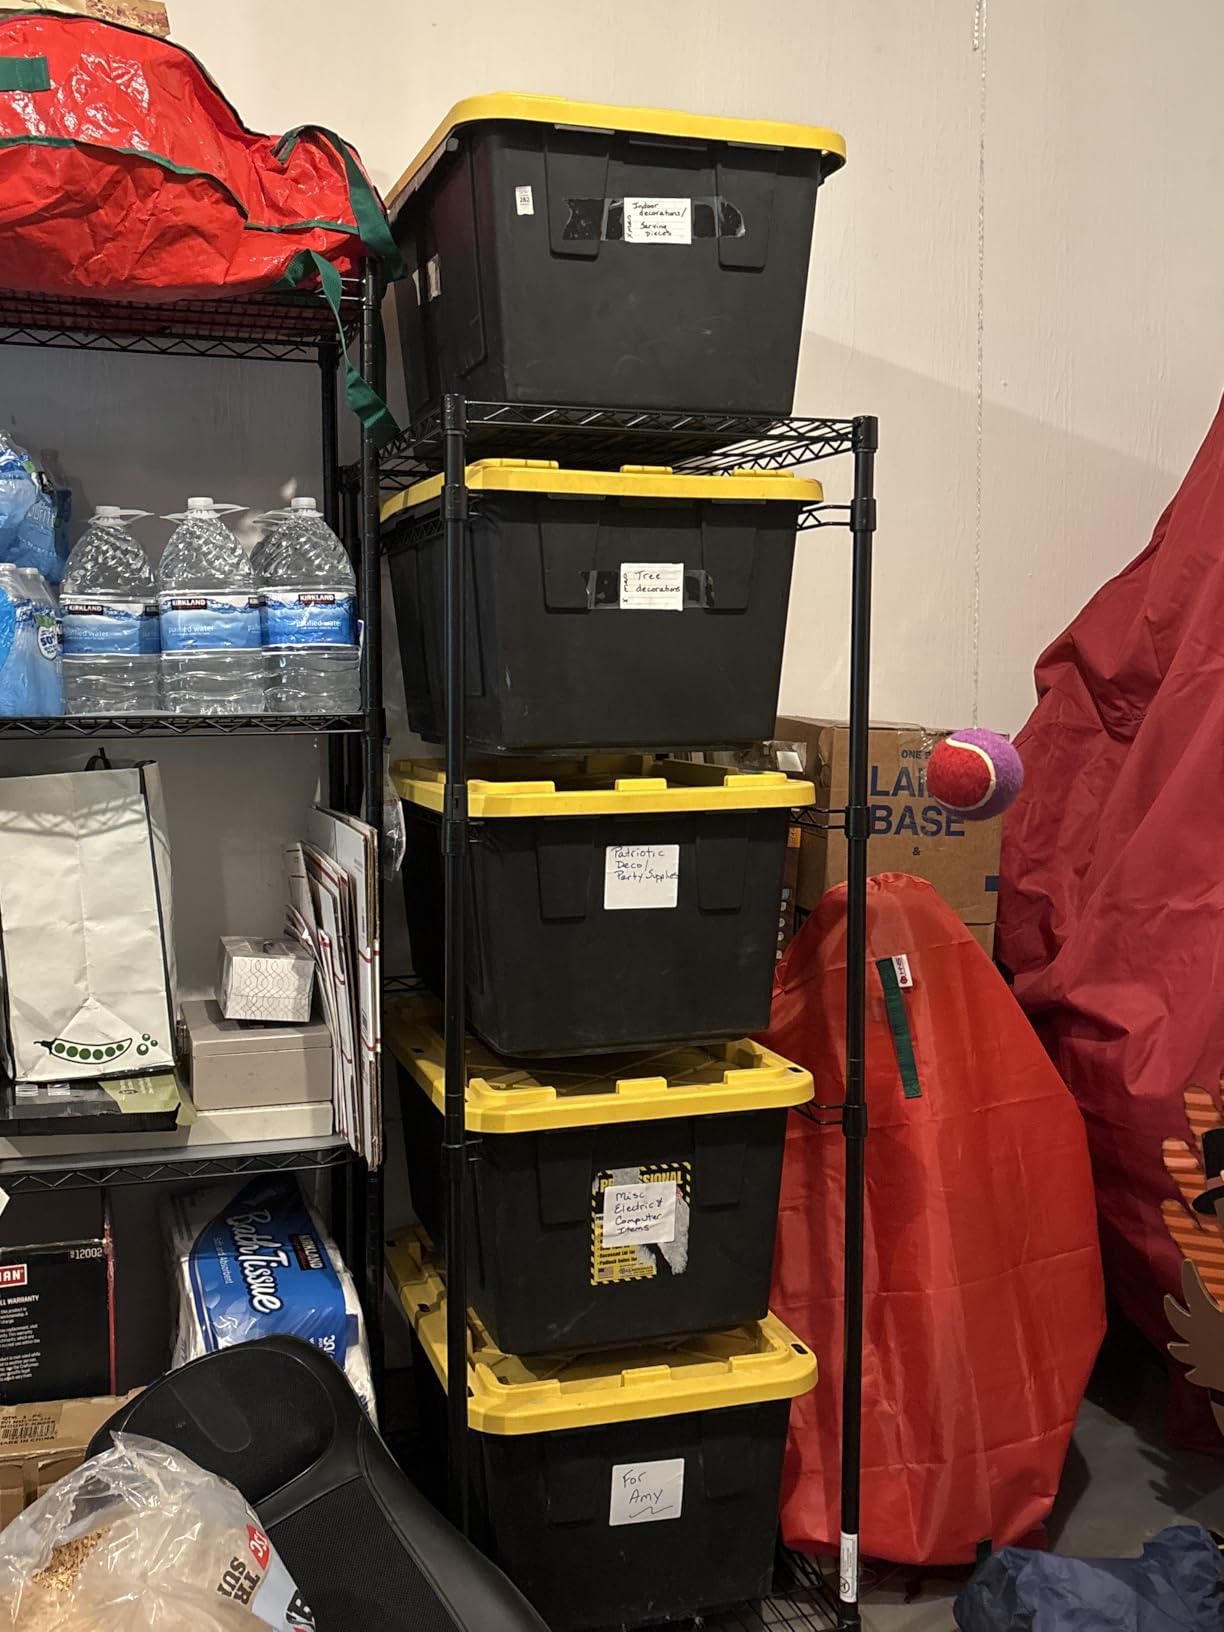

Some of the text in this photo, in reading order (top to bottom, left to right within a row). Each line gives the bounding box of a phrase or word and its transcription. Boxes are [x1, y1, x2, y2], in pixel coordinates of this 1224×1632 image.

[631, 201, 660, 210] Indoor
[633, 570, 662, 581] Tree
[635, 583, 681, 593] decorations
[901, 750, 921, 759] ONE
[871, 804, 966, 837] BASE
[610, 846, 666, 859] Patriotic
[912, 846, 921, 856] &
[613, 870, 644, 884] Party
[616, 1192, 646, 1202] Misc
[614, 1202, 654, 1214] Electric
[615, 1213, 663, 1226] Computer
[226, 1208, 283, 1258] Bath
[617, 1225, 650, 1235] Items
[299, 1234, 324, 1270] KIRKLAND
[237, 1249, 290, 1314] Tissue
[7, 1294, 40, 1305] WARRANTY
[622, 1468, 647, 1489] For
[628, 1488, 664, 1505] Amy
